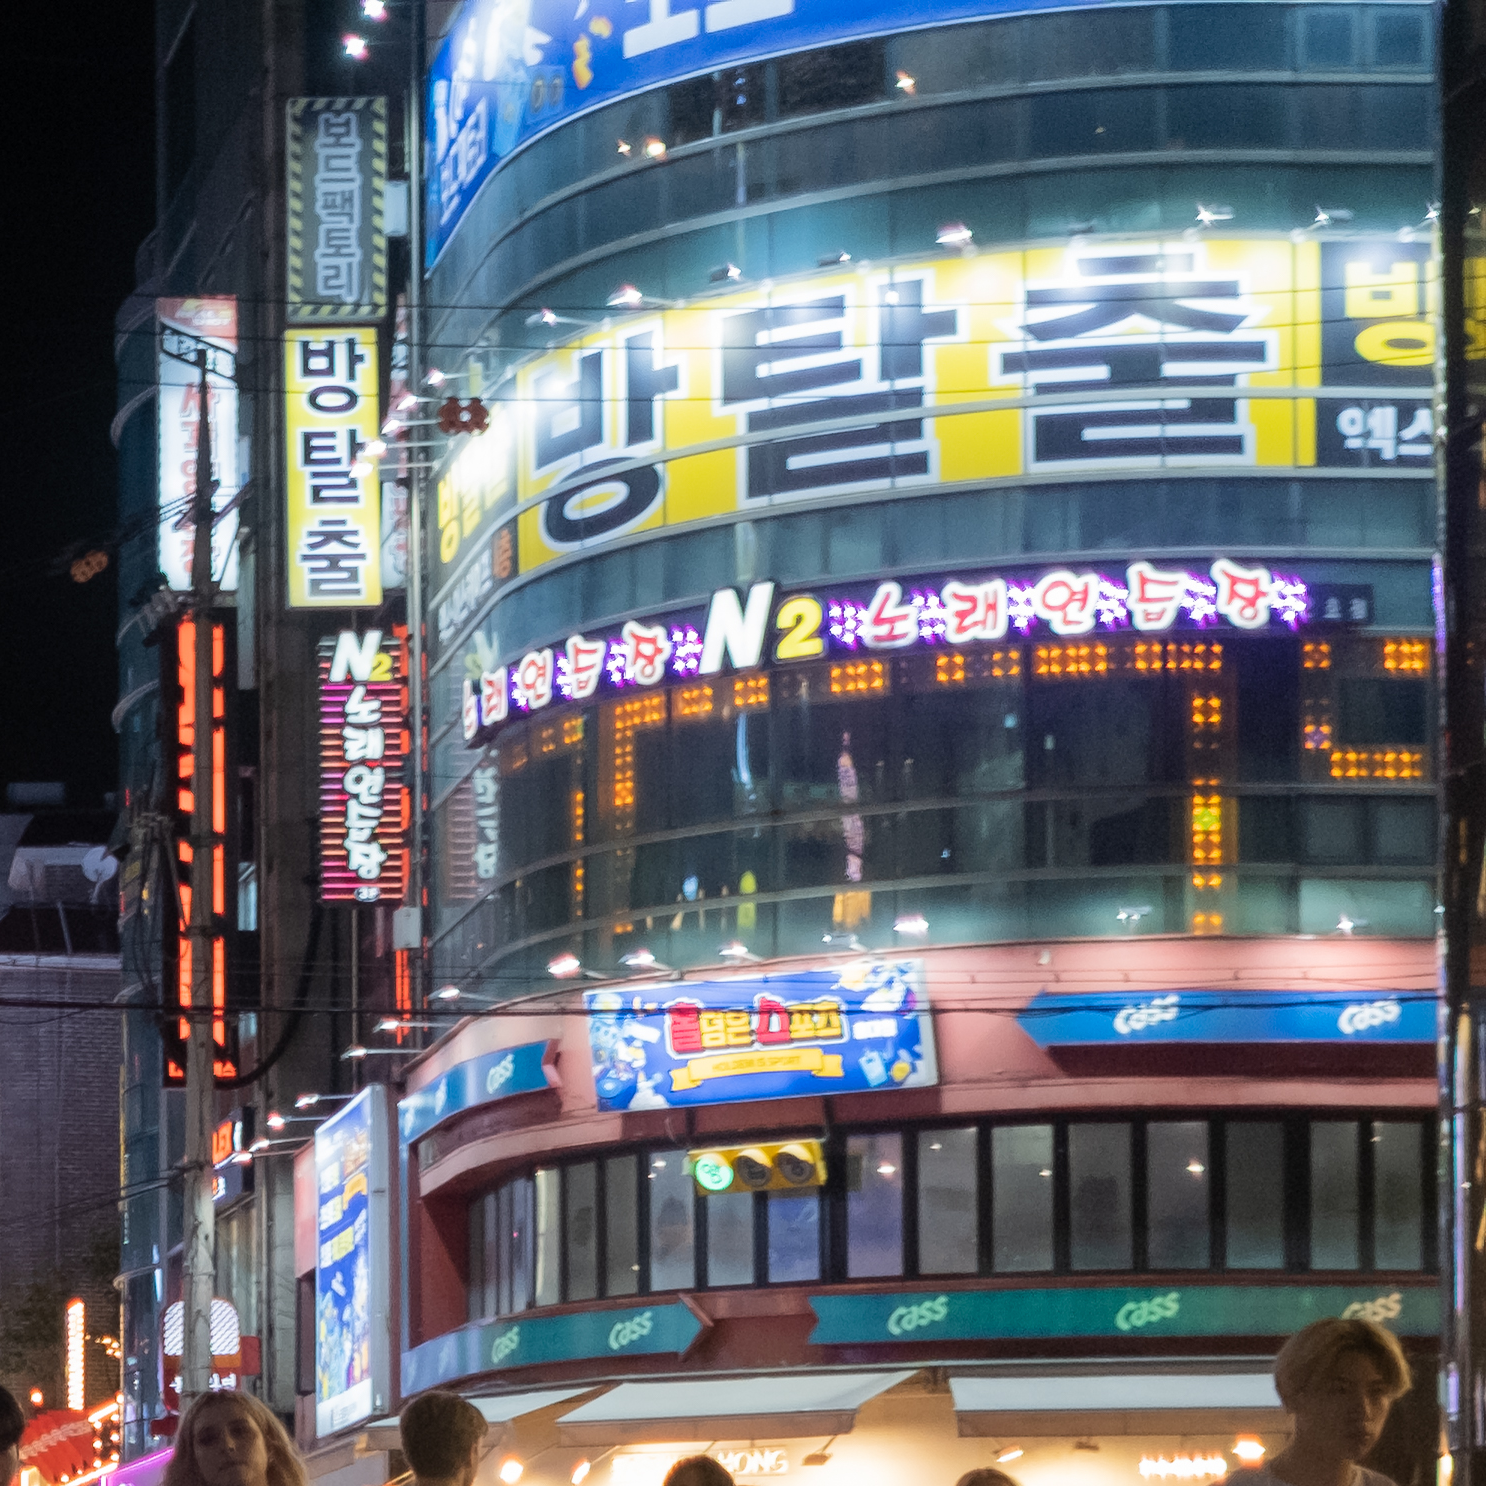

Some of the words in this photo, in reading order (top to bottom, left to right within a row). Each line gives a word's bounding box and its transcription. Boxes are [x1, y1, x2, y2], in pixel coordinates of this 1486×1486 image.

[298, 337, 366, 598] 방탈출
[529, 243, 1279, 548] 방탈출
[329, 630, 394, 682] N2
[700, 583, 824, 674] N2
[864, 558, 1272, 648] 노래연습장
[342, 685, 388, 879] 노래연습장
